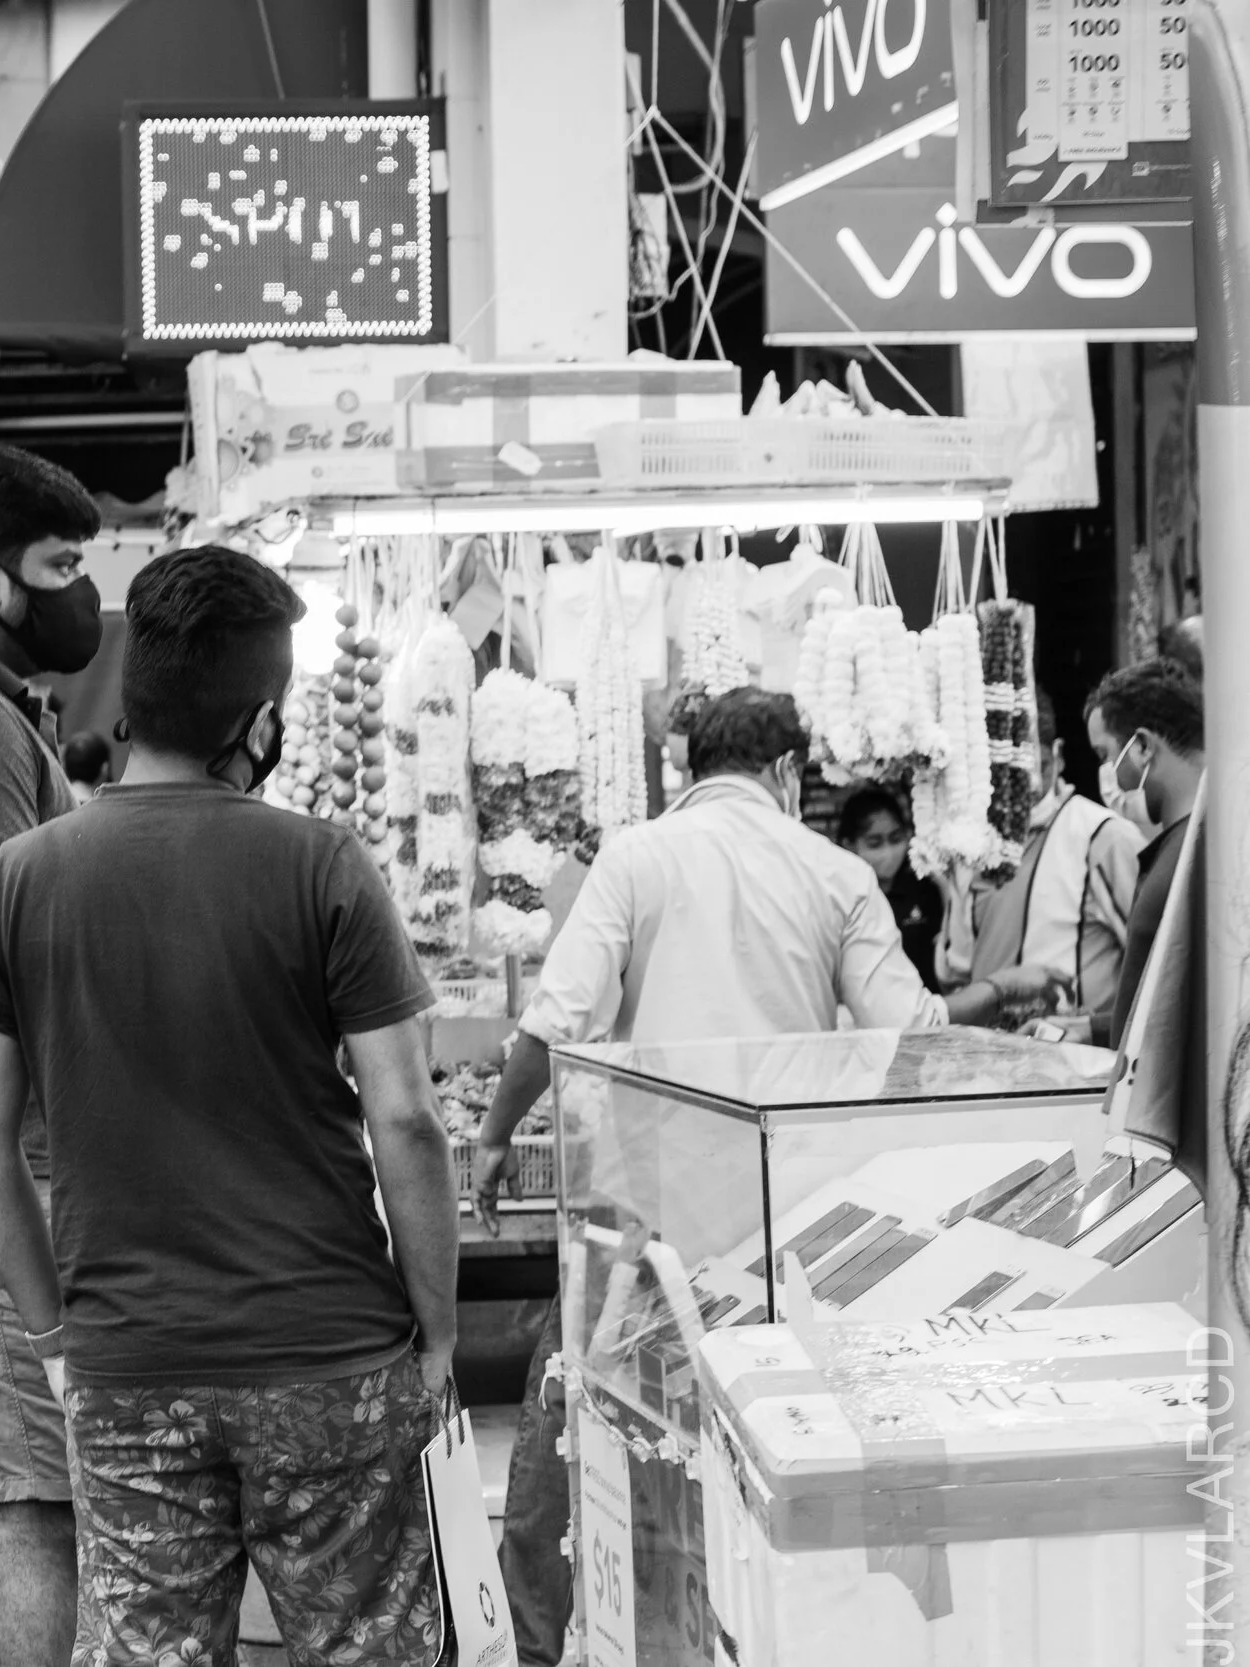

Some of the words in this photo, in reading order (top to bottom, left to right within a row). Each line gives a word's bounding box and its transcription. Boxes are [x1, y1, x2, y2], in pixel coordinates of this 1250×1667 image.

[1068, 18, 1121, 38] 1000
[1159, 16, 1187, 35] 50
[1068, 54, 1121, 73] 1000
[1159, 52, 1187, 71] 50
[836, 202, 1152, 299] vivo
[593, 1529, 622, 1618] $15
